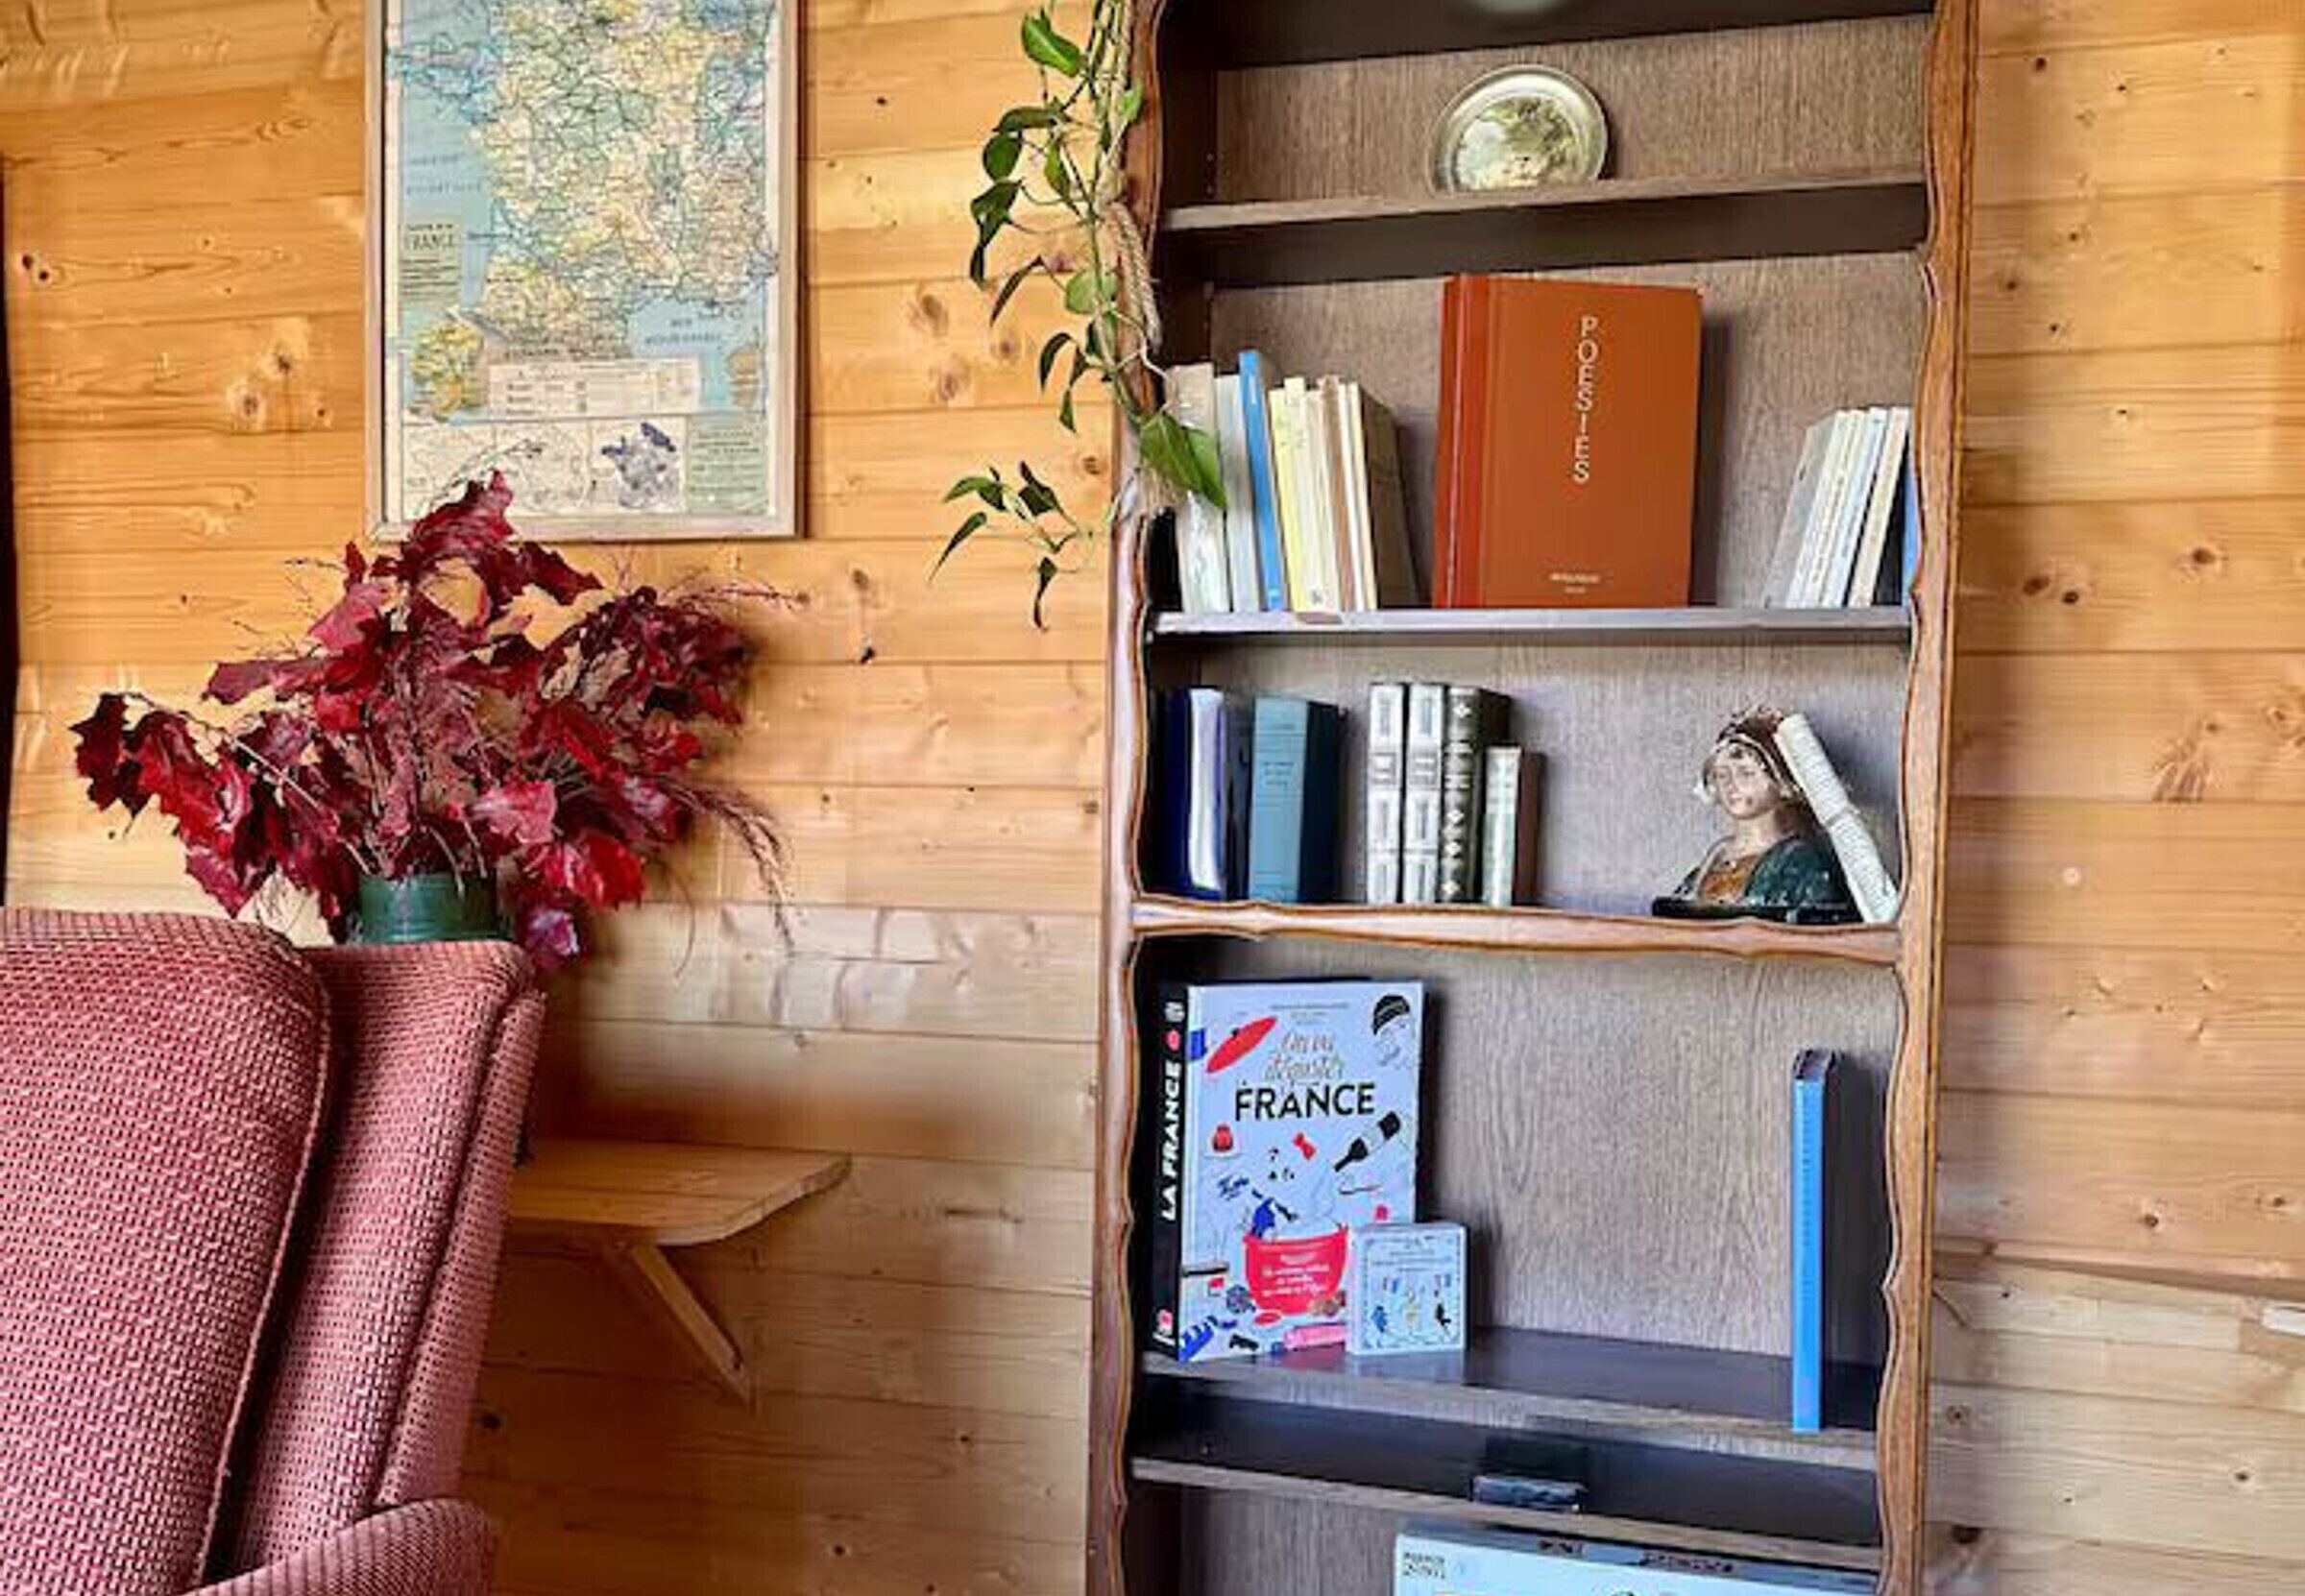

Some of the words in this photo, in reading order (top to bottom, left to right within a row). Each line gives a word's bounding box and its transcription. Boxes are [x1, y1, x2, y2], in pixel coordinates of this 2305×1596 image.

[1161, 1060, 1183, 1179] FRANCE
[1234, 1081, 1376, 1123] FRANCE
[1161, 1183, 1177, 1222] LA
